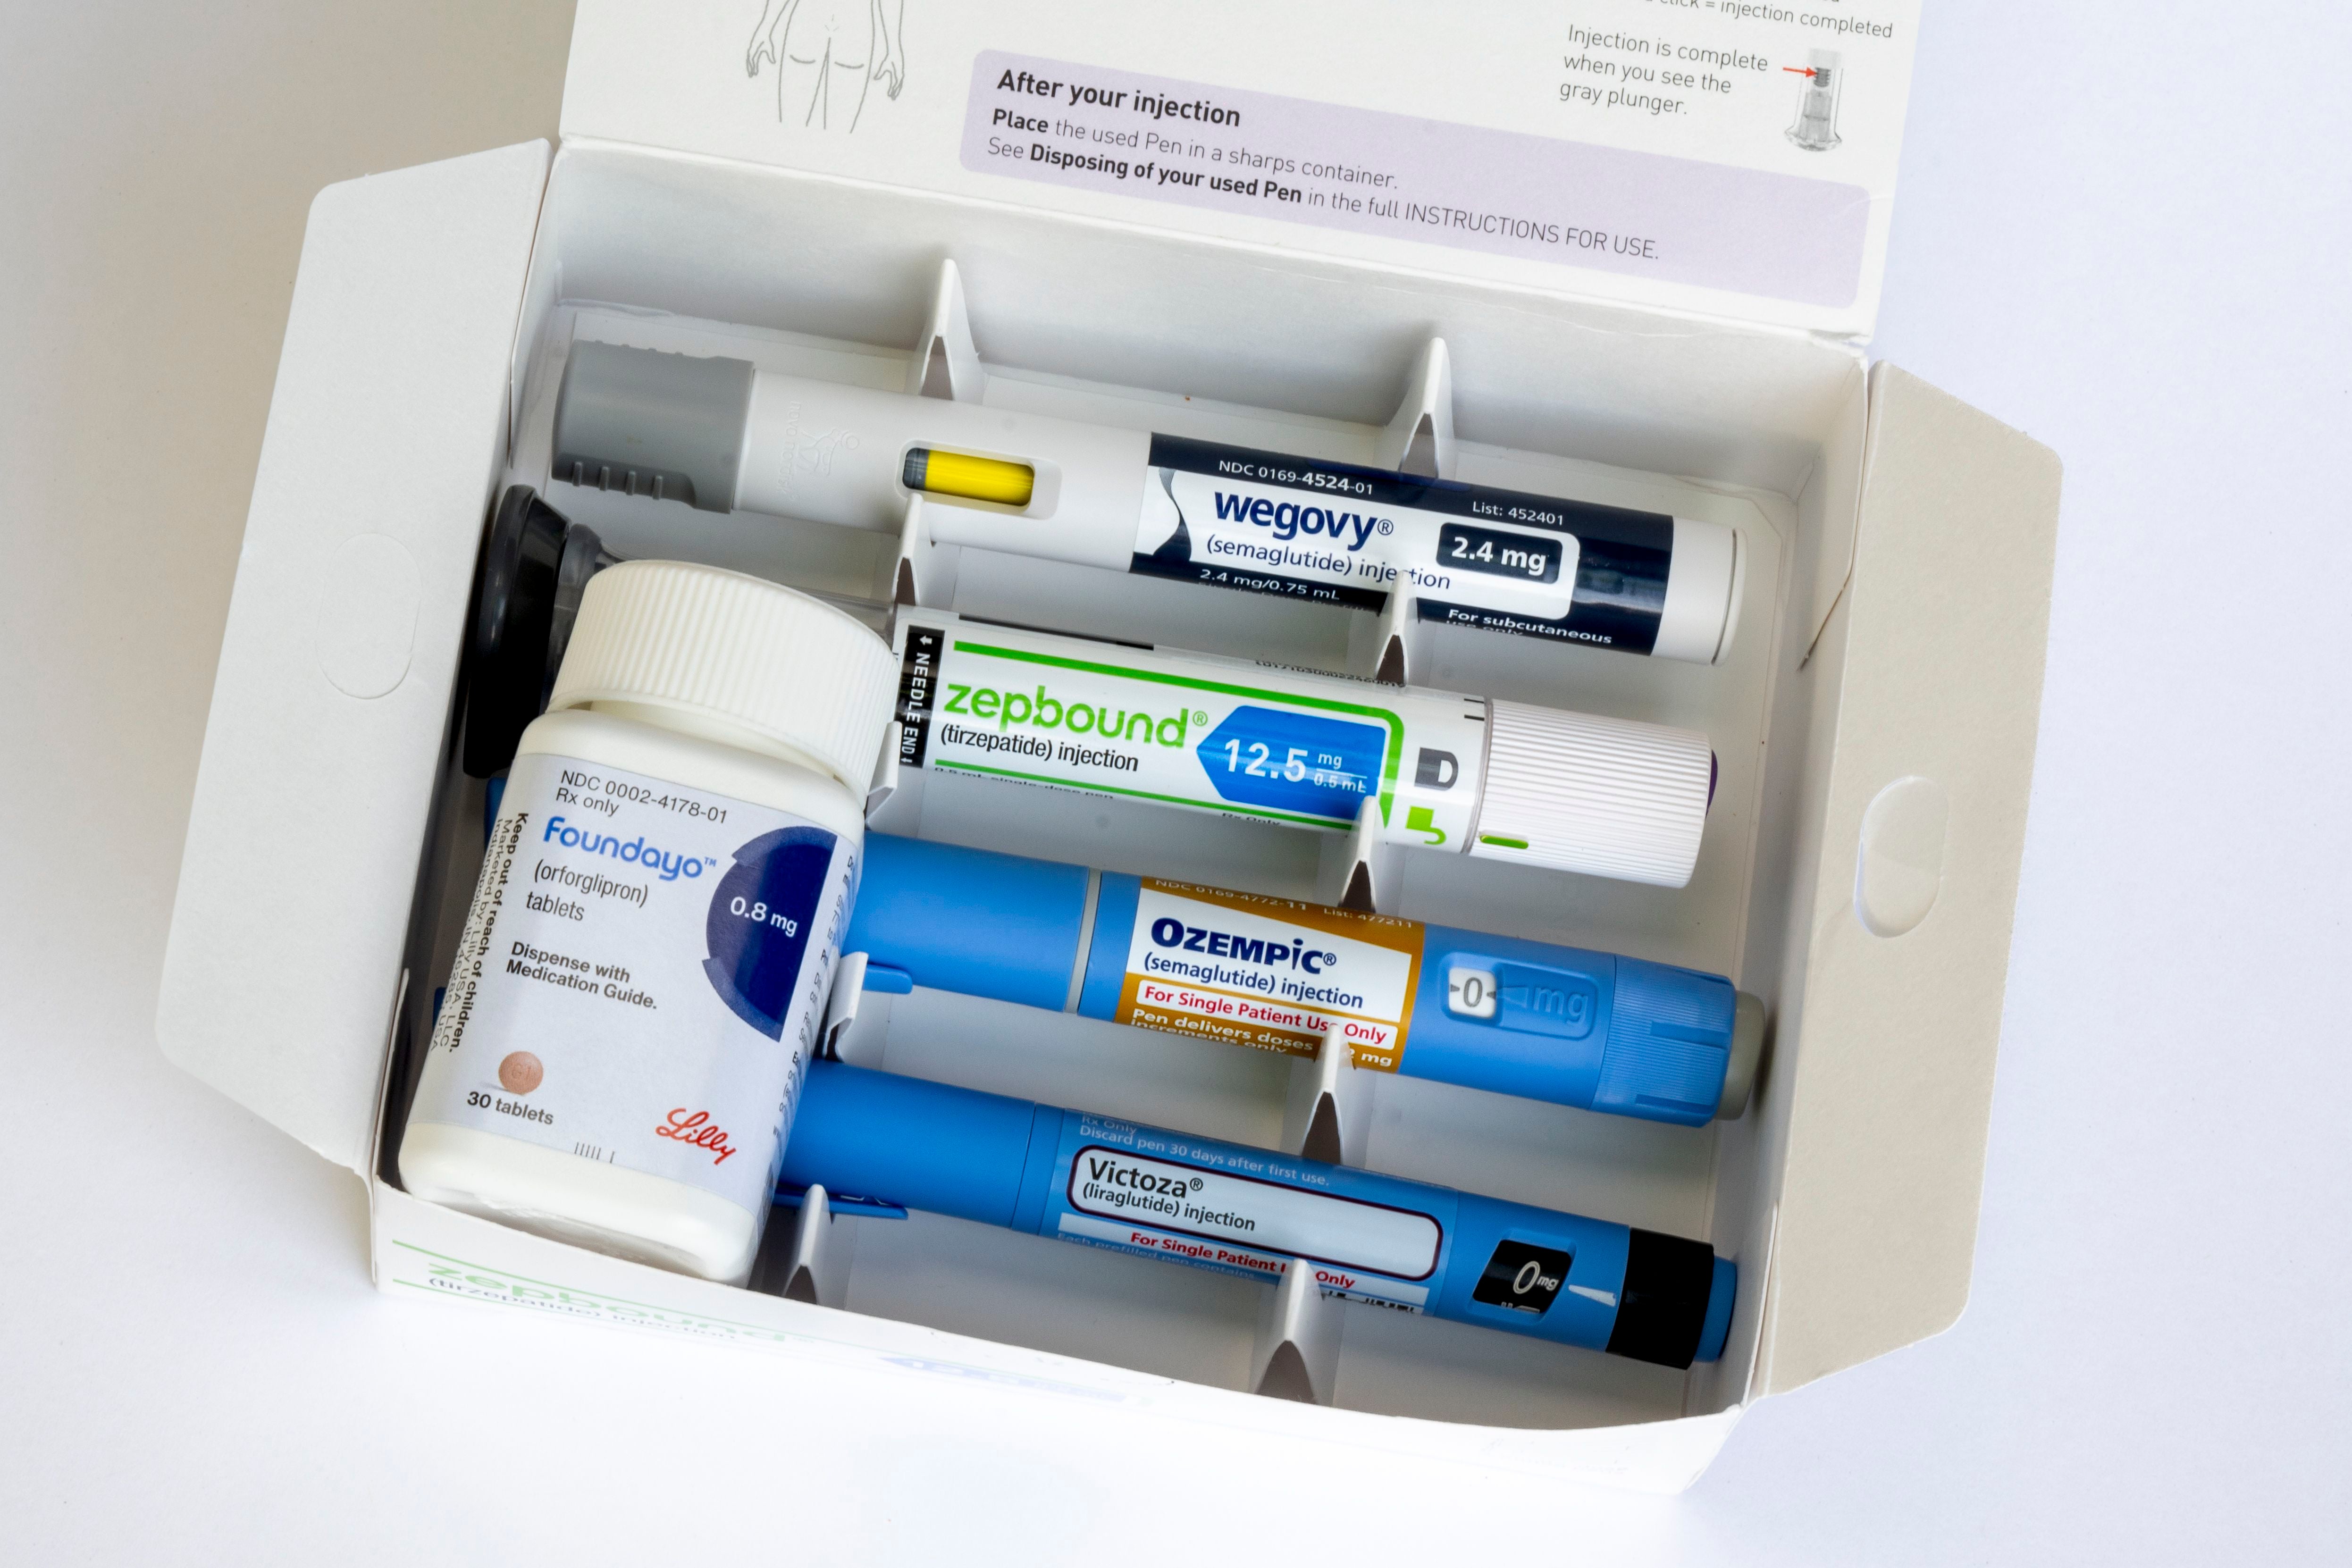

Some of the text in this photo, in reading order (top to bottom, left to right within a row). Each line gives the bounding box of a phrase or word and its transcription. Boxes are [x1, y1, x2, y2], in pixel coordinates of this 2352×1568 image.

[1721, 0, 1794, 23] injection
[1800, 12, 1892, 38] completed
[1568, 24, 1768, 72] Injection is complete
[1564, 54, 1731, 94] when you see the
[997, 69, 1240, 127] After your injection
[1560, 81, 1687, 116] gray plunger.
[992, 109, 1398, 189] Place the used Pen in a sharps container.
[988, 136, 1659, 260] See Disposing of your used Pen in the full INSTRUCTIONS FOR USE.
[1219, 460, 1373, 495] NDC 0169-4524-01
[1214, 492, 1394, 551] wegovy®
[1473, 501, 1563, 525] List: 452401
[1207, 534, 1450, 589] (semaglutide) injetion
[1452, 537, 1547, 577] 2.4 mg
[1200, 569, 1228, 583] 2.4
[1233, 574, 1307, 595] mg/0.75
[1313, 586, 1340, 600] mL
[1448, 609, 1612, 644] For subcutaneous
[901, 652, 930, 754] NEEDLE END
[941, 723, 1139, 772] (tirzepatide) injection
[1225, 738, 1342, 782] 12.5 mg
[556, 788, 620, 817] Rx only
[561, 770, 727, 824] NDC 0002-4178-01
[1314, 775, 1367, 793] 0.5 mL
[484, 819, 512, 896] Marketed
[535, 859, 648, 908] (orforglipron)
[1156, 879, 1191, 891] NDC
[476, 901, 488, 924] by:
[526, 892, 585, 922] tablets
[730, 897, 798, 937] 0.8 mg
[1324, 908, 1353, 919] List:
[450, 813, 529, 1052] Keep out of reach of children.
[464, 931, 480, 962] Lilly
[511, 941, 630, 983] Dispense with
[1144, 951, 1363, 1009] (semaglutide) injection
[506, 959, 658, 1010] Medication Guide.
[1463, 977, 1589, 1024] 0 mg
[440, 1015, 455, 1046] LLC
[1131, 1019, 1287, 1053] increments only
[1144, 986, 1387, 1045] For Single Patient Us Only
[1133, 1008, 1168, 1024] Pen
[1175, 1016, 1252, 1040] delivers
[1257, 1032, 1313, 1051] doses
[1361, 1053, 1392, 1067] mg
[467, 1091, 554, 1125] 30 tablets
[1082, 1115, 1137, 1135] Rx Only
[655, 1108, 737, 1165] Lilly
[1079, 1125, 1330, 1186] Discard pen 30 days after first use.
[1089, 1157, 1203, 1198] Victoza®
[1083, 1182, 1256, 1231] (liraglutide) injection
[1130, 1232, 1159, 1247] For
[1161, 1239, 1213, 1259] Single
[1218, 1249, 1282, 1272] Patient
[1316, 1270, 1355, 1289] Only
